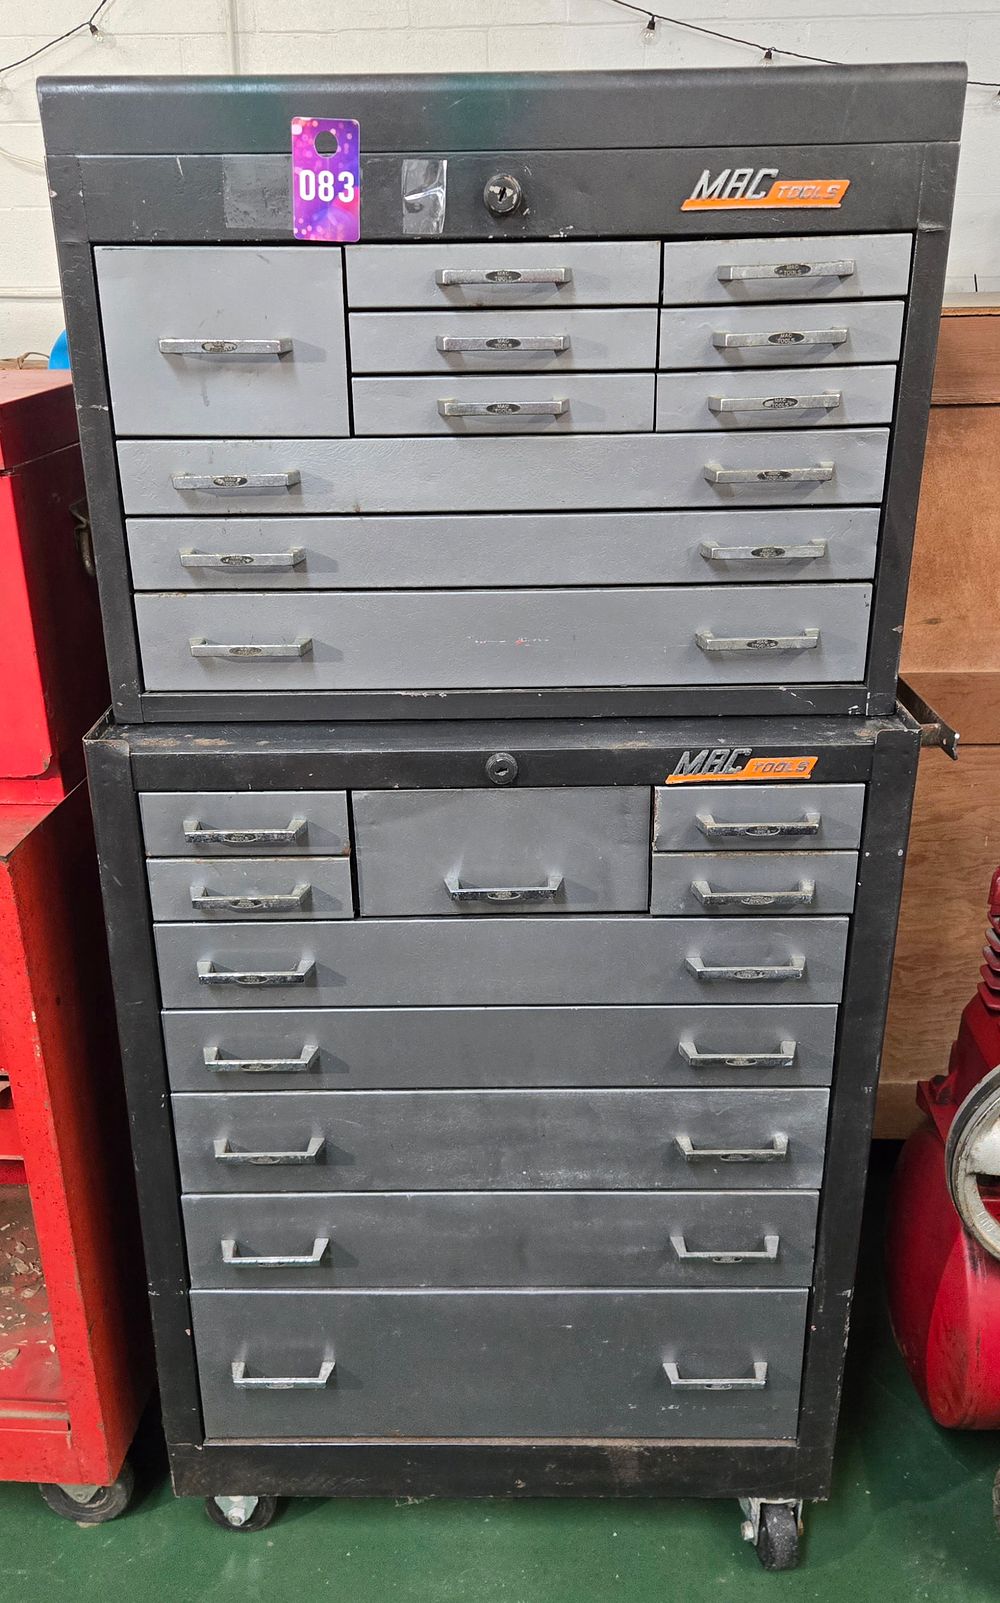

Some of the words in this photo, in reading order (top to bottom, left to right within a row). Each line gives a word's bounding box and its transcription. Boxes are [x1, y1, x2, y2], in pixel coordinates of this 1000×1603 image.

[299, 170, 355, 202] 083
[690, 168, 779, 200] MAC
[778, 184, 840, 200] TOOLS
[672, 748, 752, 776] MAC
[754, 761, 810, 774] TOOLS
